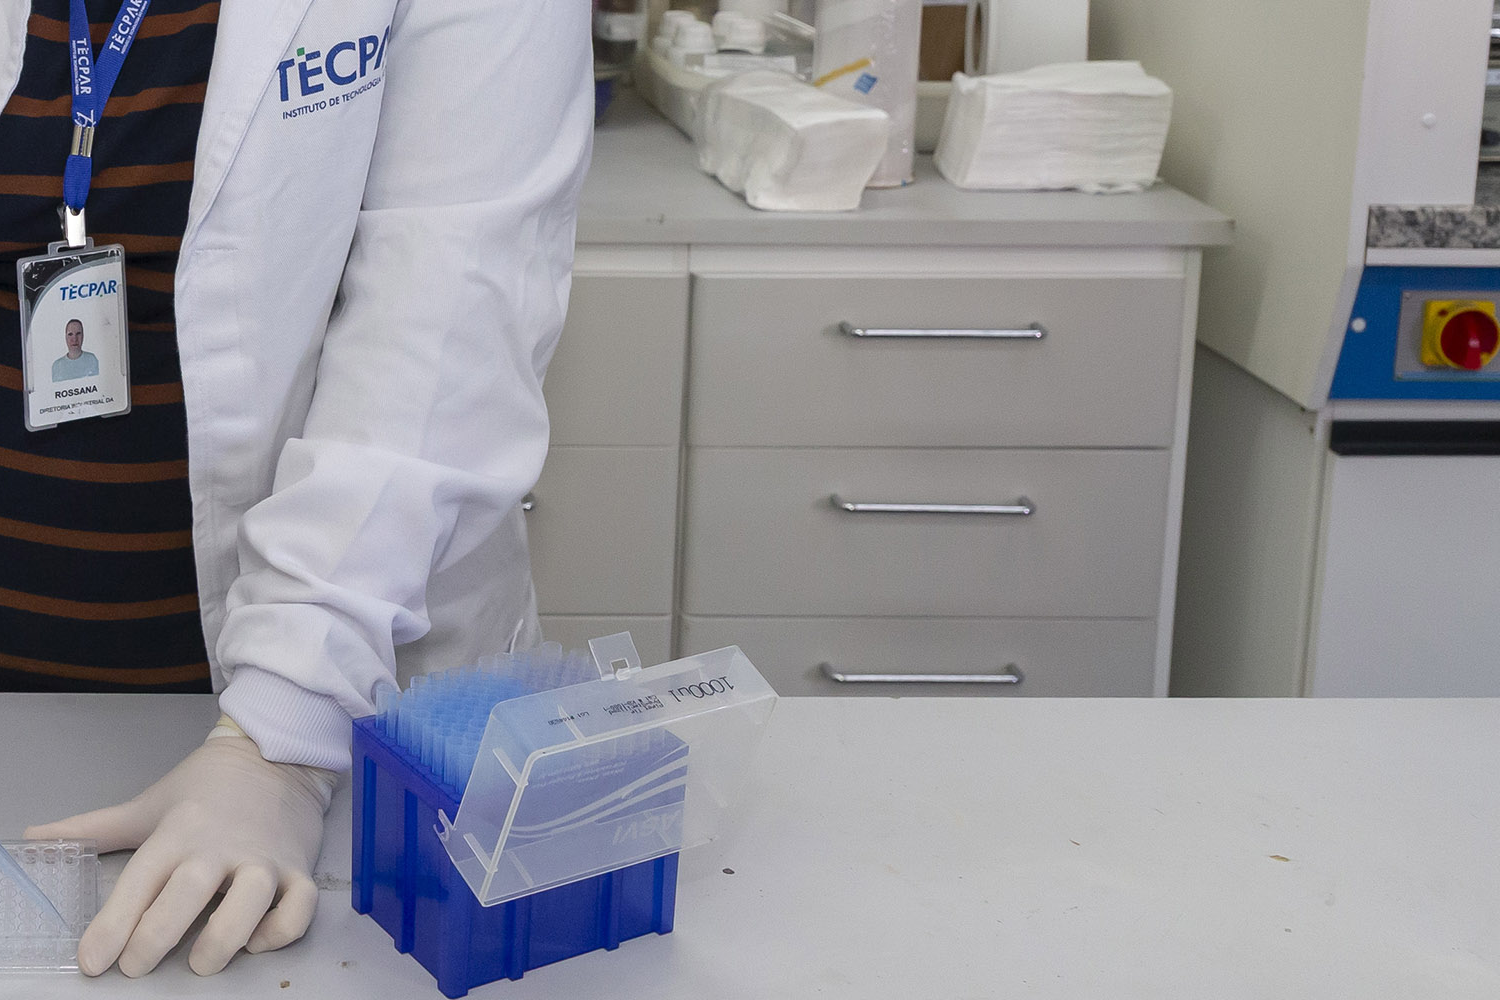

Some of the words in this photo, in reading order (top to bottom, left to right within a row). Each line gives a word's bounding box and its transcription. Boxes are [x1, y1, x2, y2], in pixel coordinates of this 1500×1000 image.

[282, 100, 327, 120] INSTITUTO
[329, 96, 341, 107] DE
[342, 77, 382, 103] TECNOLOGIA
[54, 385, 98, 399] ROSSANA
